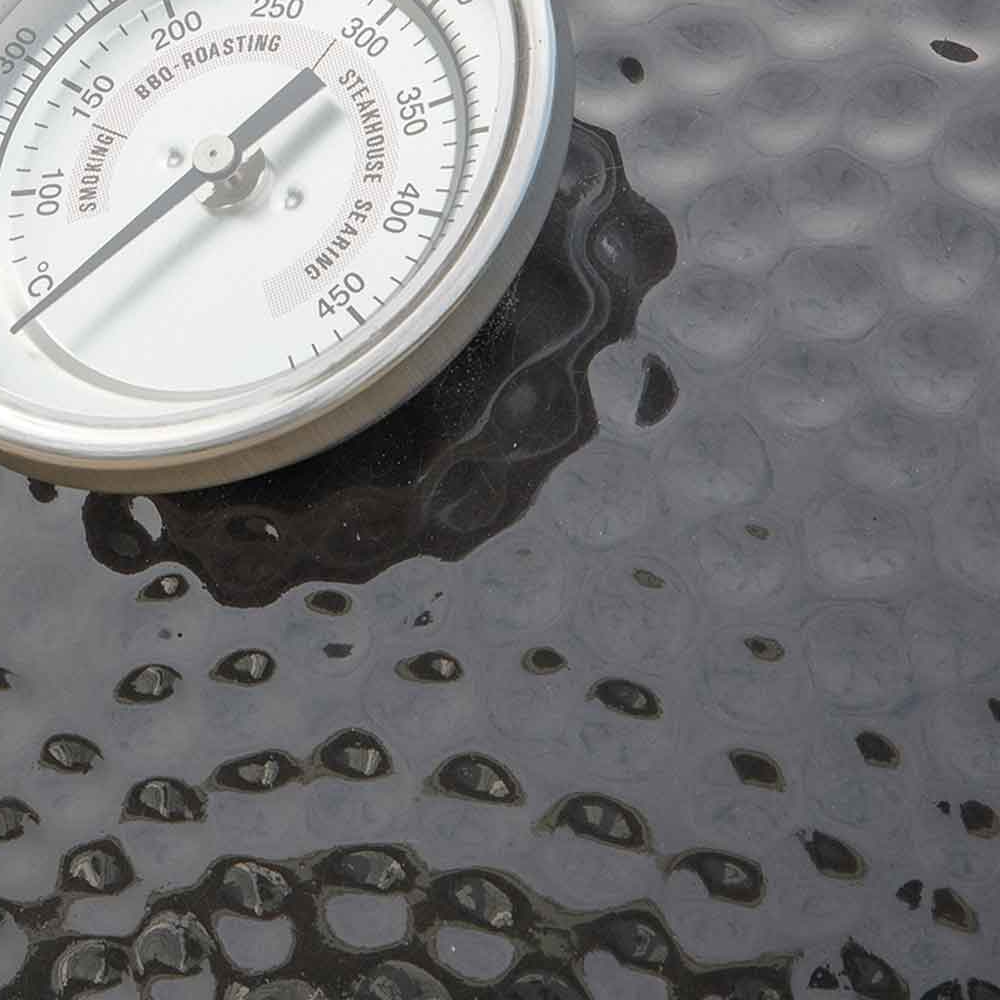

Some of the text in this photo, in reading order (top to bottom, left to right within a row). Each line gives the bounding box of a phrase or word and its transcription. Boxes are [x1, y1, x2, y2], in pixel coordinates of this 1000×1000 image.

[151, 10, 203, 51] 200
[341, 17, 389, 58] 300
[134, 33, 282, 101] BBQ-ROASTING
[72, 74, 115, 119] 150
[396, 86, 428, 137] 350
[338, 68, 385, 184] STEAKHOUSE
[36, 168, 64, 216] 100
[383, 183, 420, 234] 400
[303, 199, 373, 281] SEARING
[316, 271, 365, 319] 450
